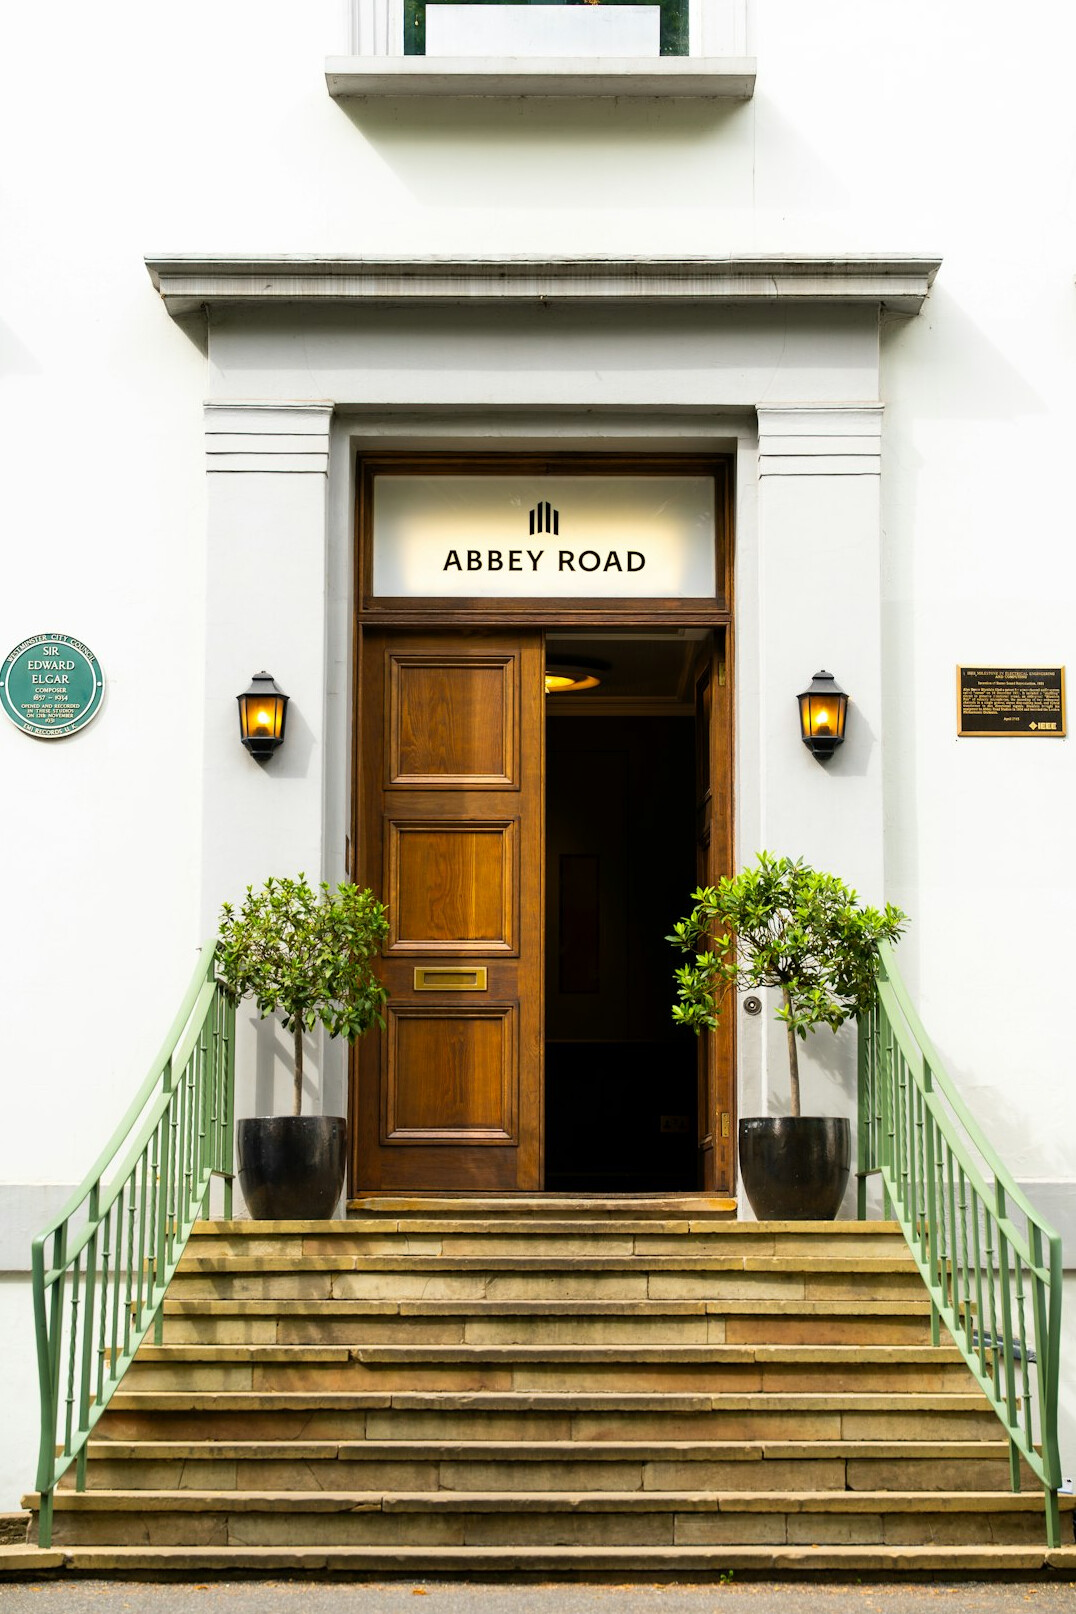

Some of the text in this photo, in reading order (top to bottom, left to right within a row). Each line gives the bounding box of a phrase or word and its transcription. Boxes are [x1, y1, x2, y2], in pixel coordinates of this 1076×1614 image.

[443, 550, 646, 572] ABBEY ROAD
[6, 634, 95, 663] WESTMINSTER CITY COUNCIL
[43, 646, 60, 656] SIR
[27, 660, 75, 670] EDWARD
[31, 674, 70, 684] ELGAR
